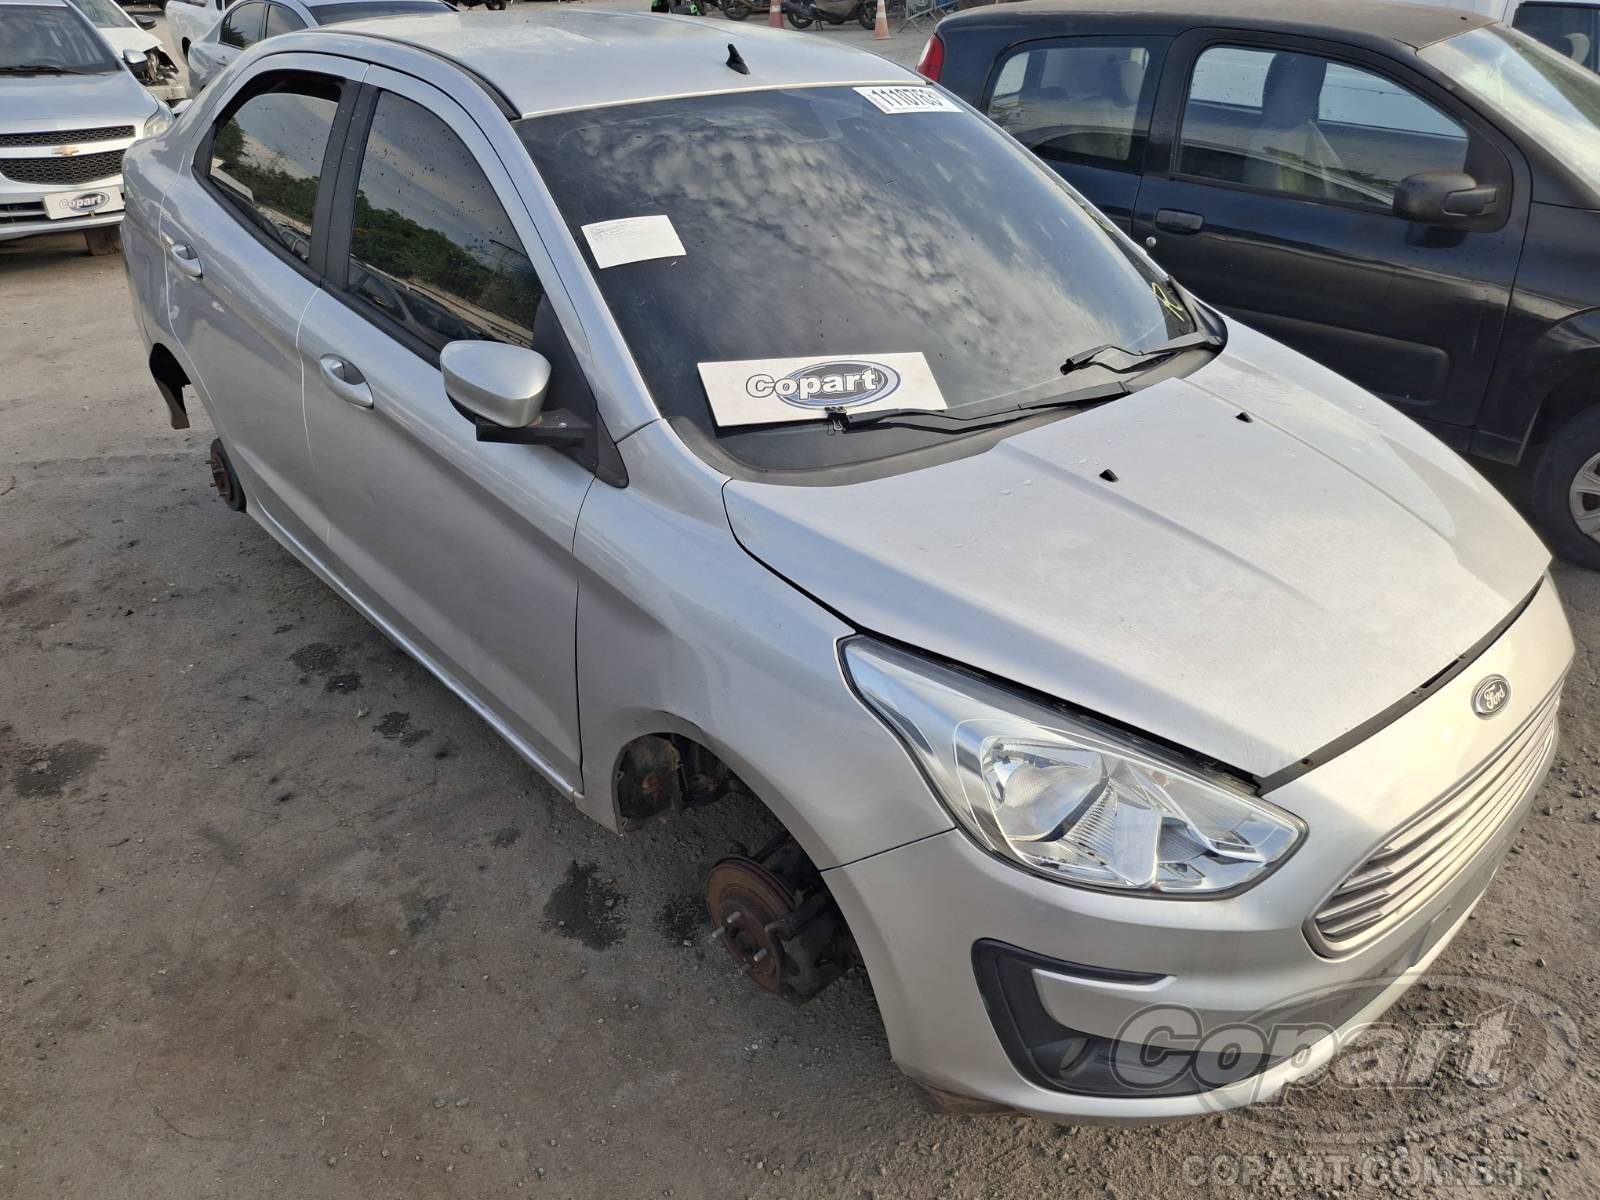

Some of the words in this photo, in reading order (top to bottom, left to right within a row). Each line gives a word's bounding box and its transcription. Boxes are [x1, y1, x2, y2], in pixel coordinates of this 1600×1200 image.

[59, 195, 102, 208] Copart
[745, 367, 879, 401] Copart
[1484, 684, 1506, 709] Ford
